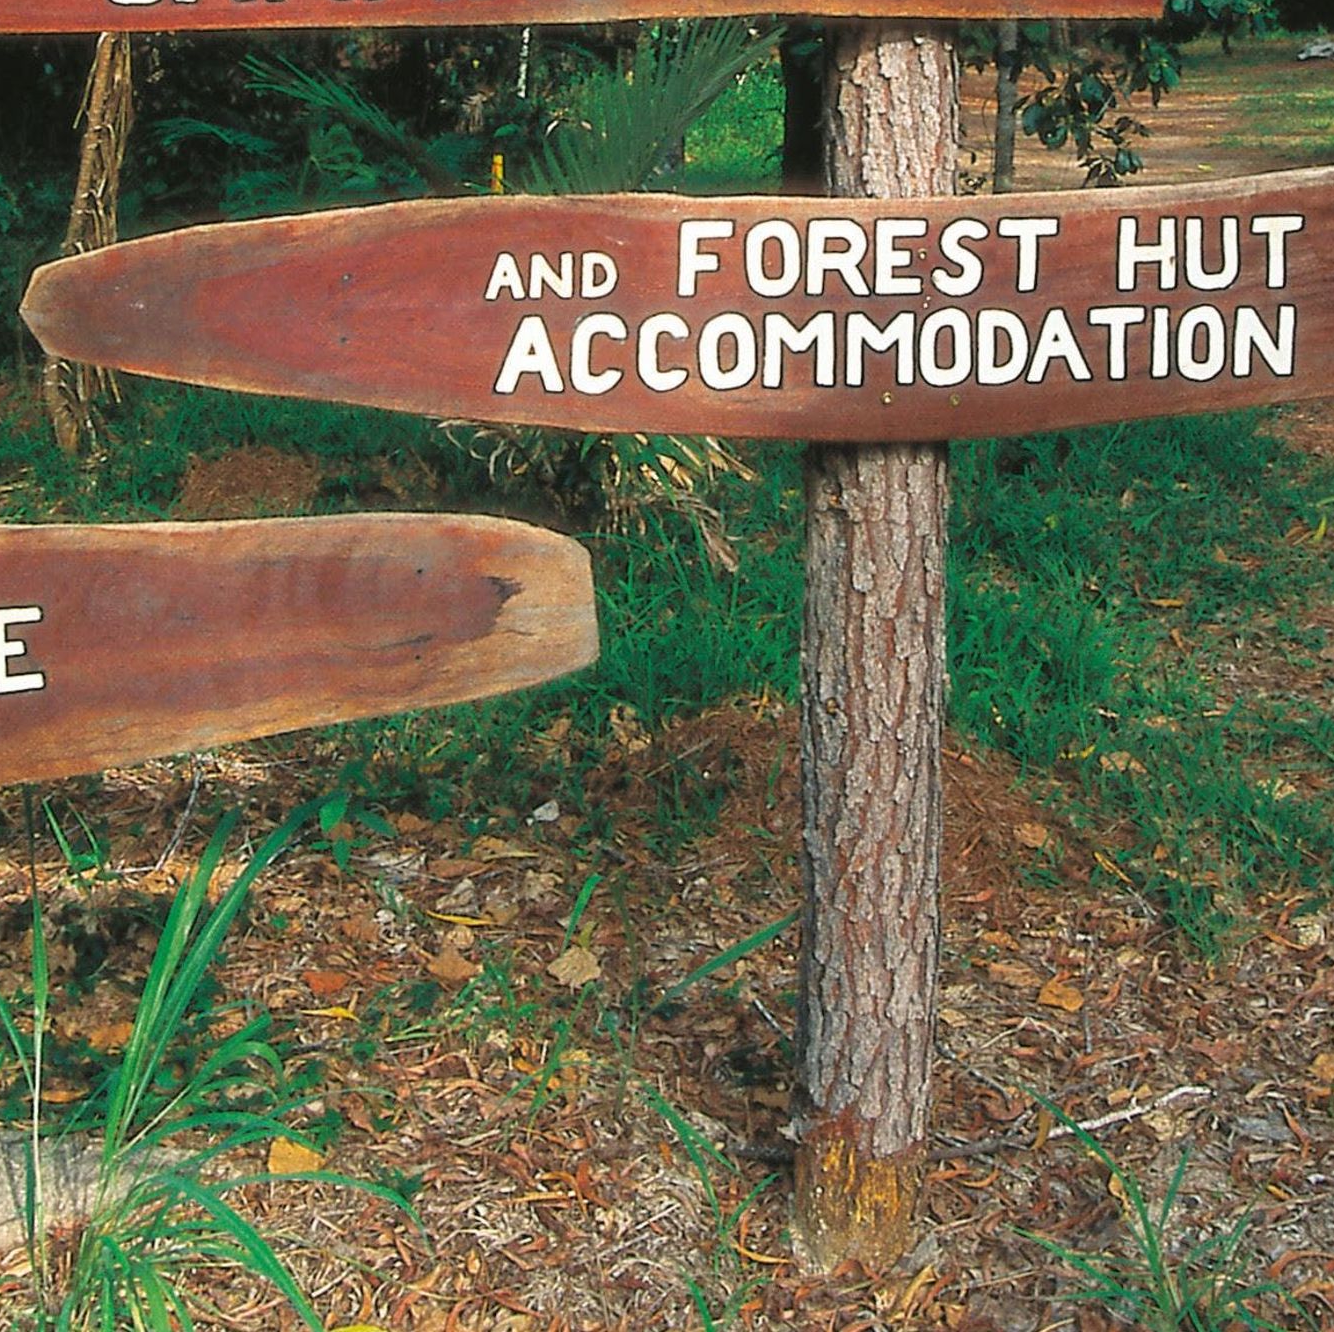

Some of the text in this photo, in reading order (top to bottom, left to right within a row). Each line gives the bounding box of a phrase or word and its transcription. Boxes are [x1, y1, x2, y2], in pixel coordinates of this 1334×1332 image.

[483, 214, 1305, 302] AND FOREST HUT
[493, 304, 1297, 395] ACCOMMODATION
